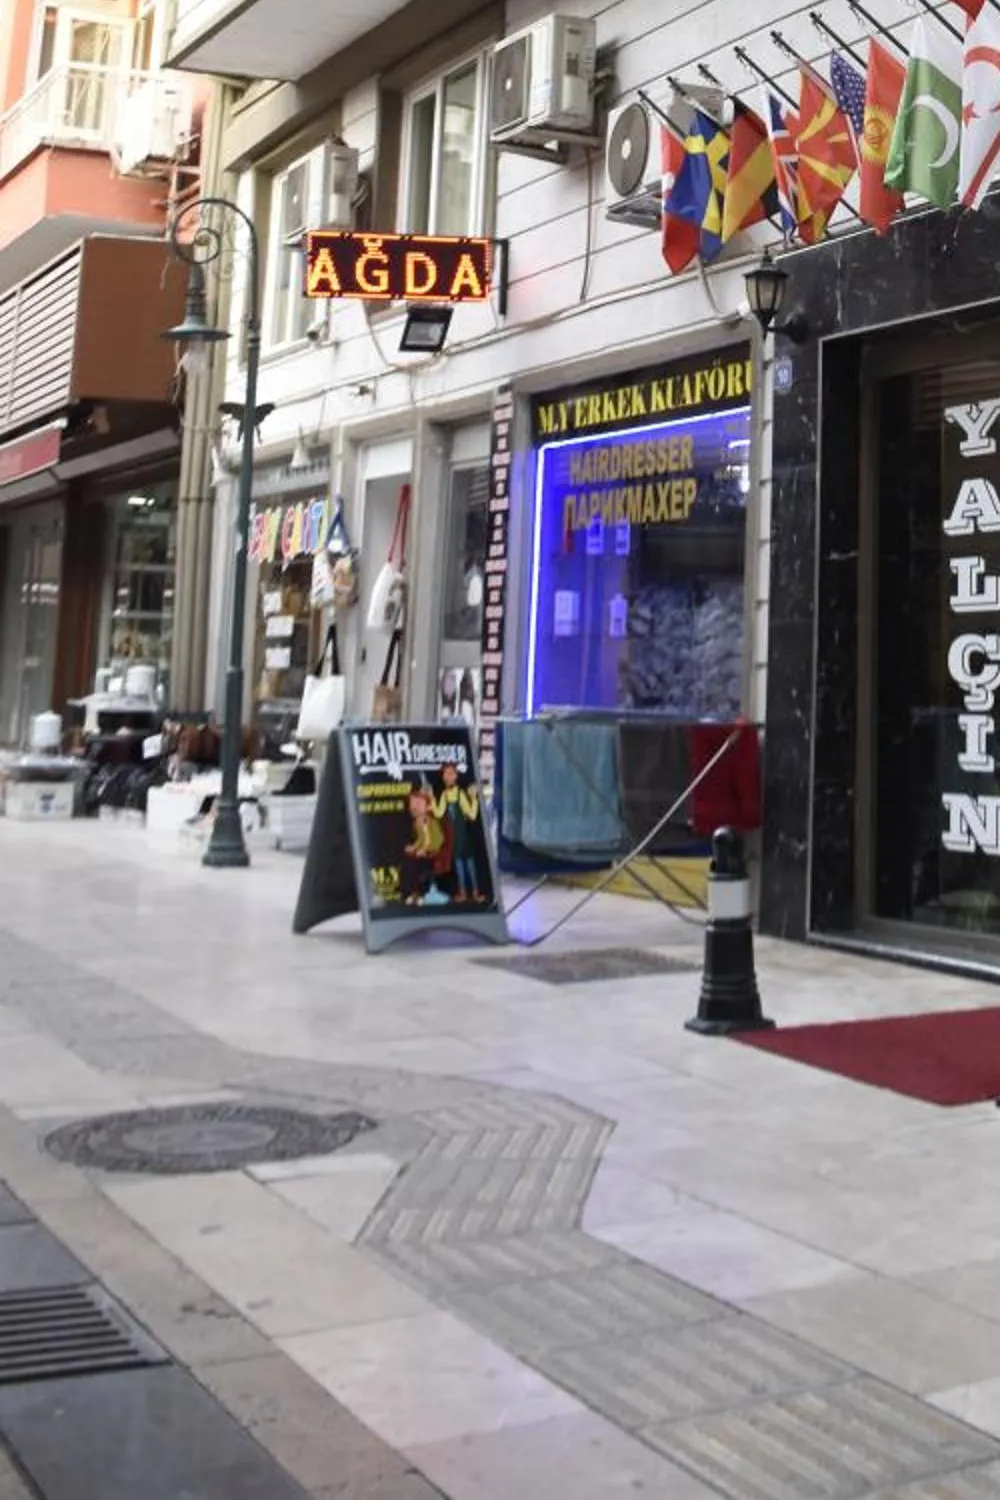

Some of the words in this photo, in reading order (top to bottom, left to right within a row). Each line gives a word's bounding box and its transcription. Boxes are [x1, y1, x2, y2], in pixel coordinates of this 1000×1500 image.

[307, 237, 484, 297] AĞDA
[573, 383, 647, 430] ERKEK
[569, 434, 695, 486] HAIRDRESSER
[563, 477, 698, 531] ПАРИКМАХЕР
[352, 730, 412, 766] HAIR
